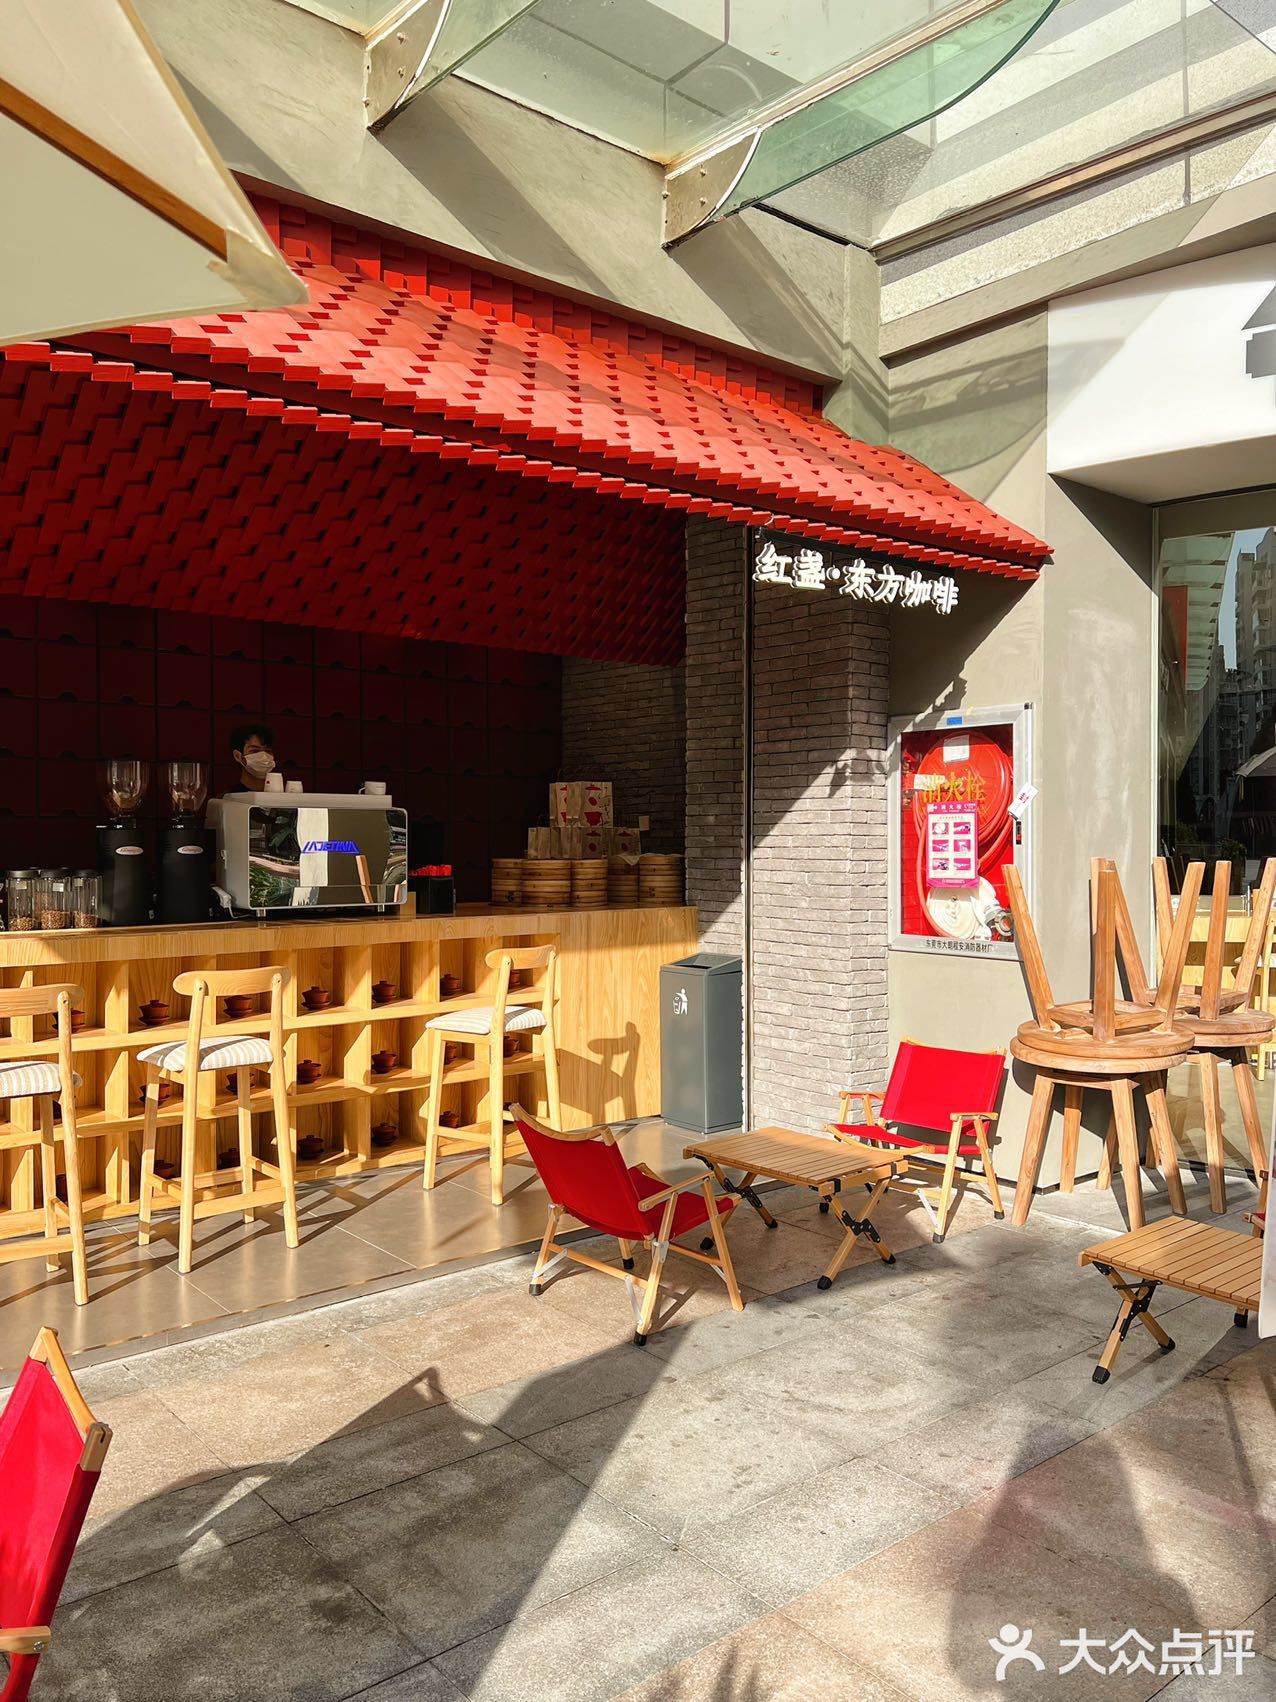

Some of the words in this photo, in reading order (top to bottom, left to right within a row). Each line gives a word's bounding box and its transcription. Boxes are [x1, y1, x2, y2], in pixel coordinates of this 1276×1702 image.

[753, 541, 960, 615] 红盏·东方咖啡
